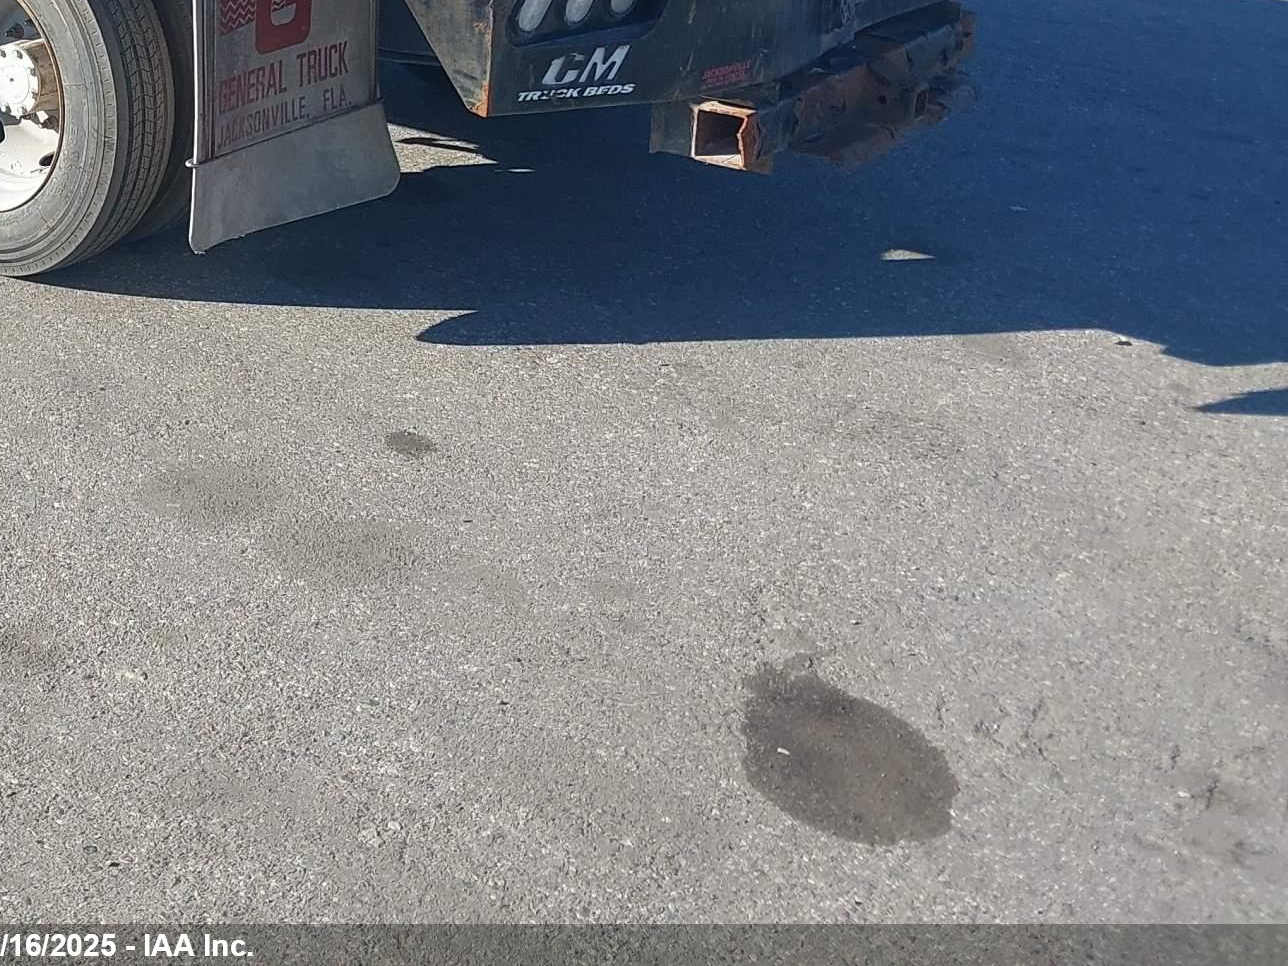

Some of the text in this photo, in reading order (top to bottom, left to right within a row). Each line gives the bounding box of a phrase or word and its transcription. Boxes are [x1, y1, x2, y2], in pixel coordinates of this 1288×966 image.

[218, 41, 349, 114] GENERAL TRUCK
[542, 44, 632, 85] CM
[216, 85, 353, 150] JACKSONVILLE, FLA.
